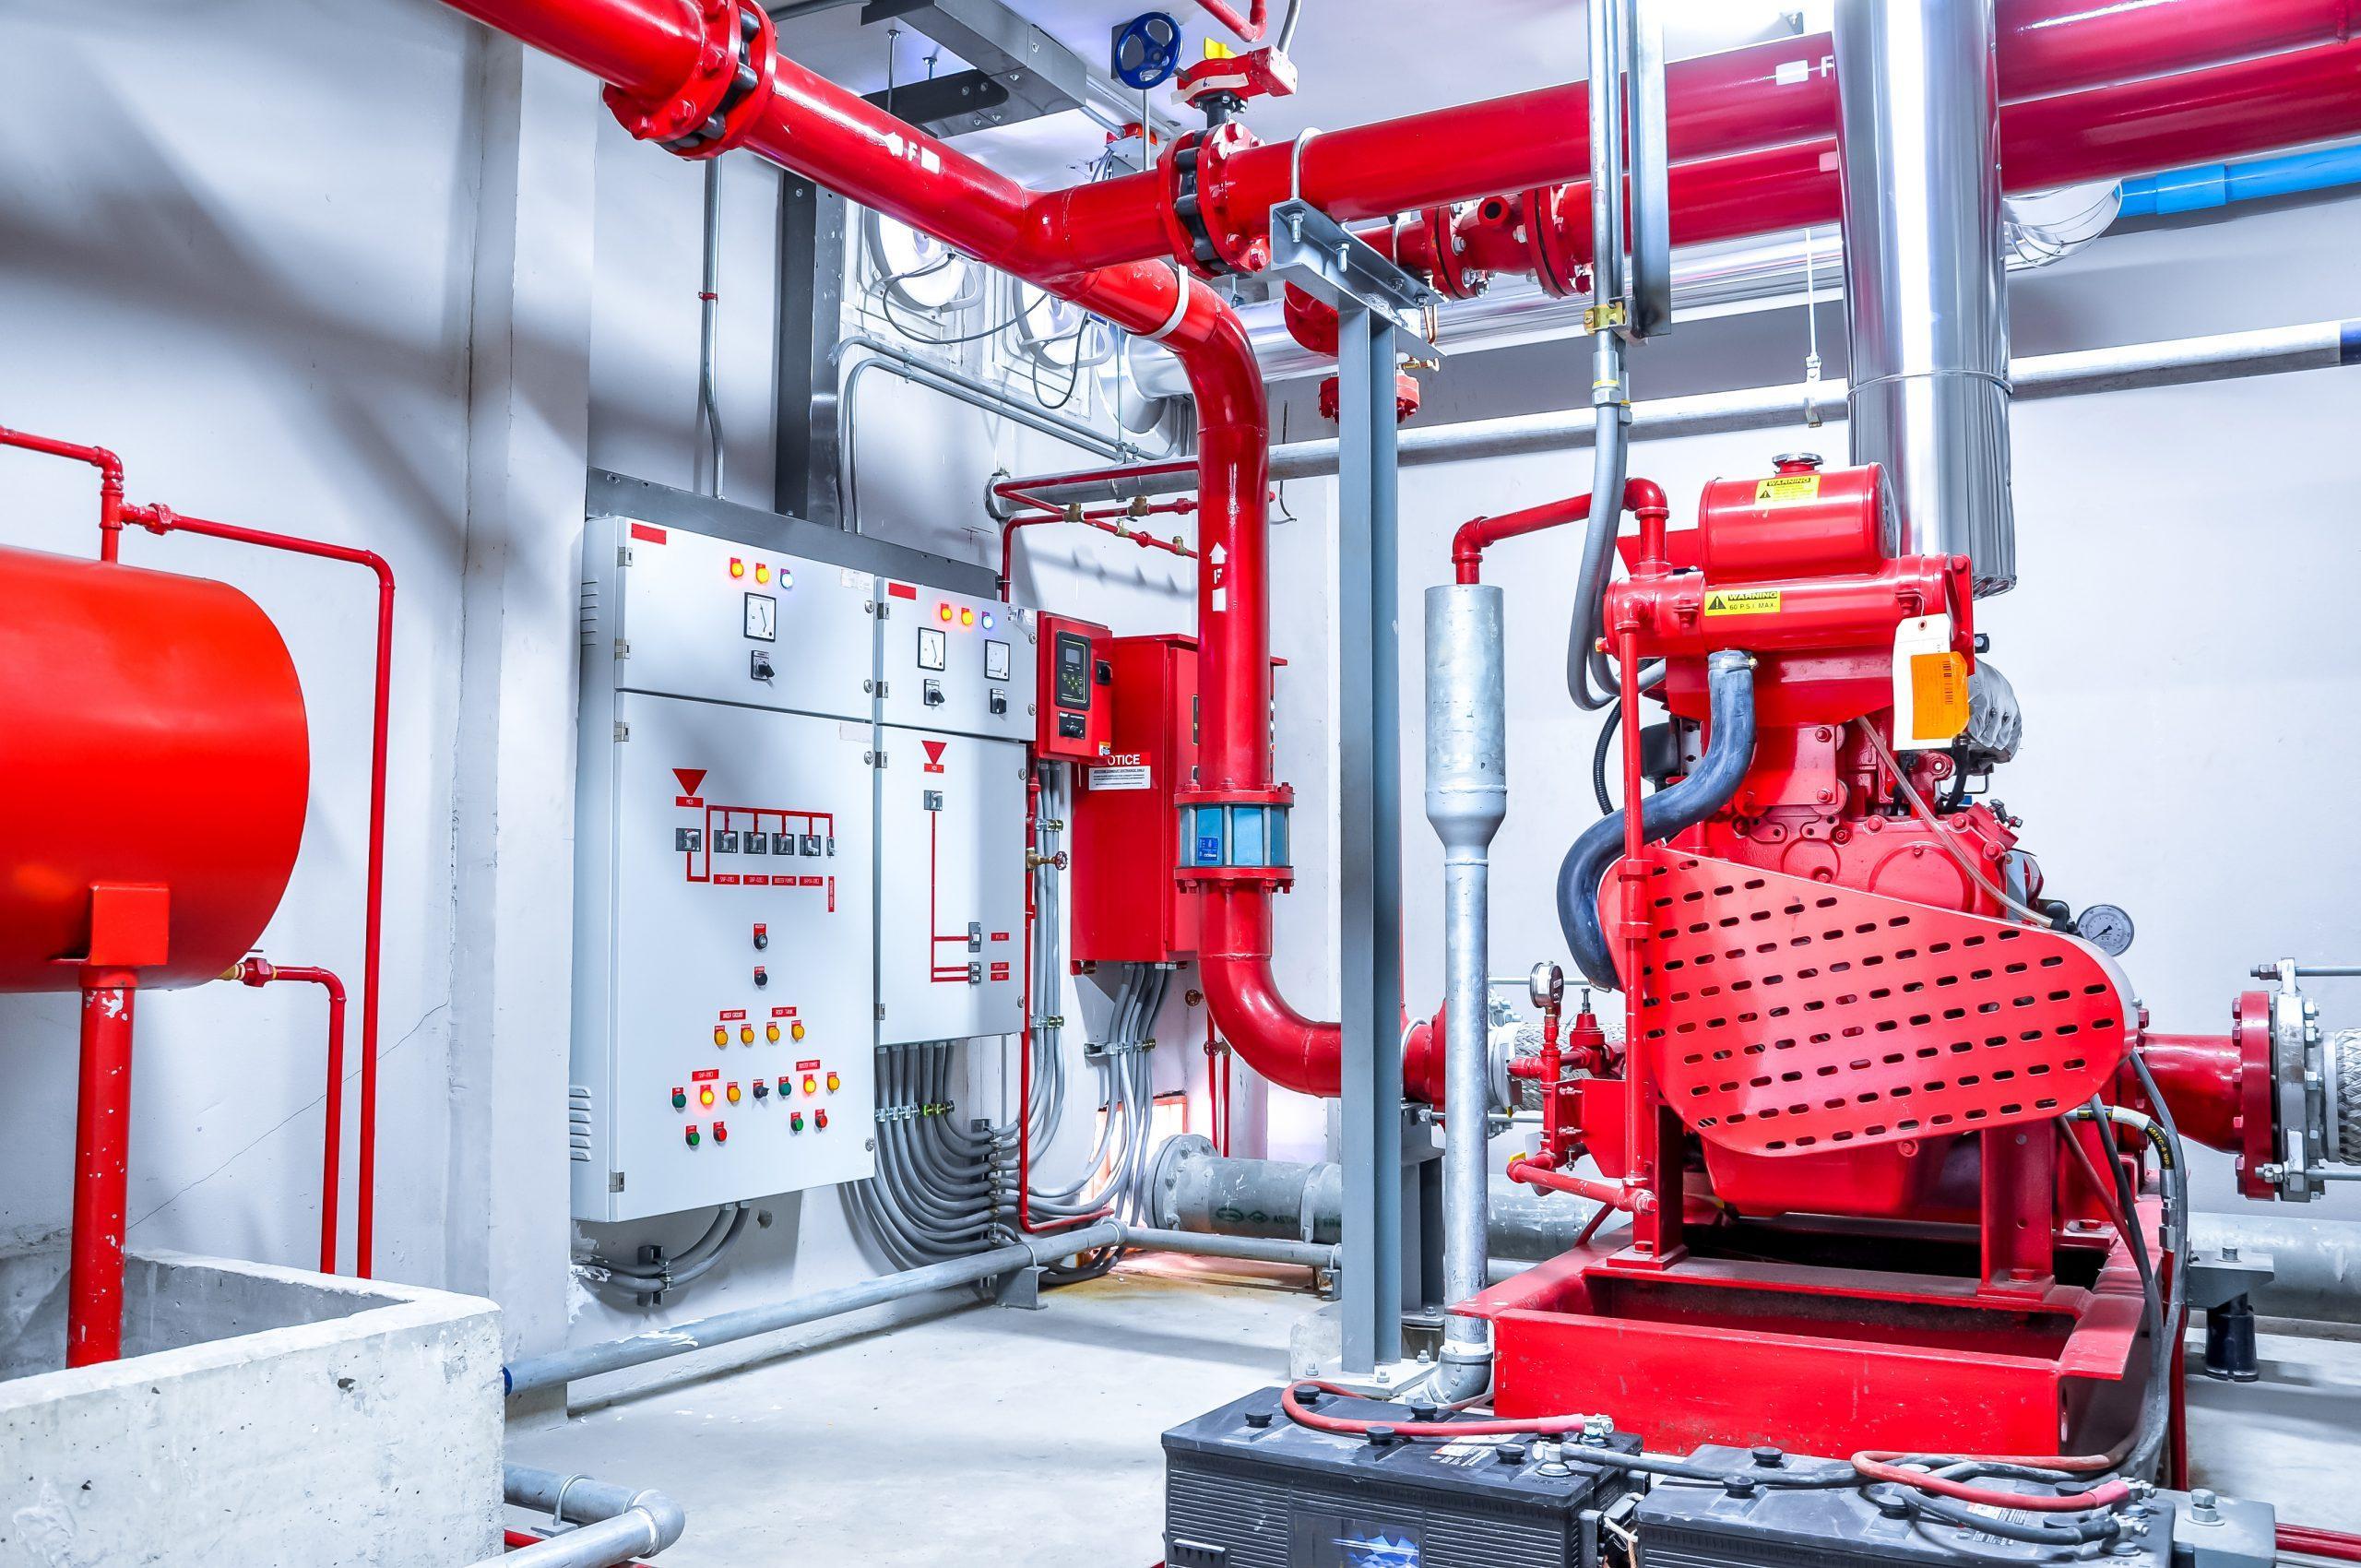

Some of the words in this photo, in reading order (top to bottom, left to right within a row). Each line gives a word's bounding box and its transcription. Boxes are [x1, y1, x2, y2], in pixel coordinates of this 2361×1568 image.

[908, 140, 918, 161] F
[1767, 478, 1811, 487] WARNING
[1213, 567, 1223, 585] F
[1727, 591, 1778, 601] WARNING
[1107, 754, 1141, 766] OTICE
